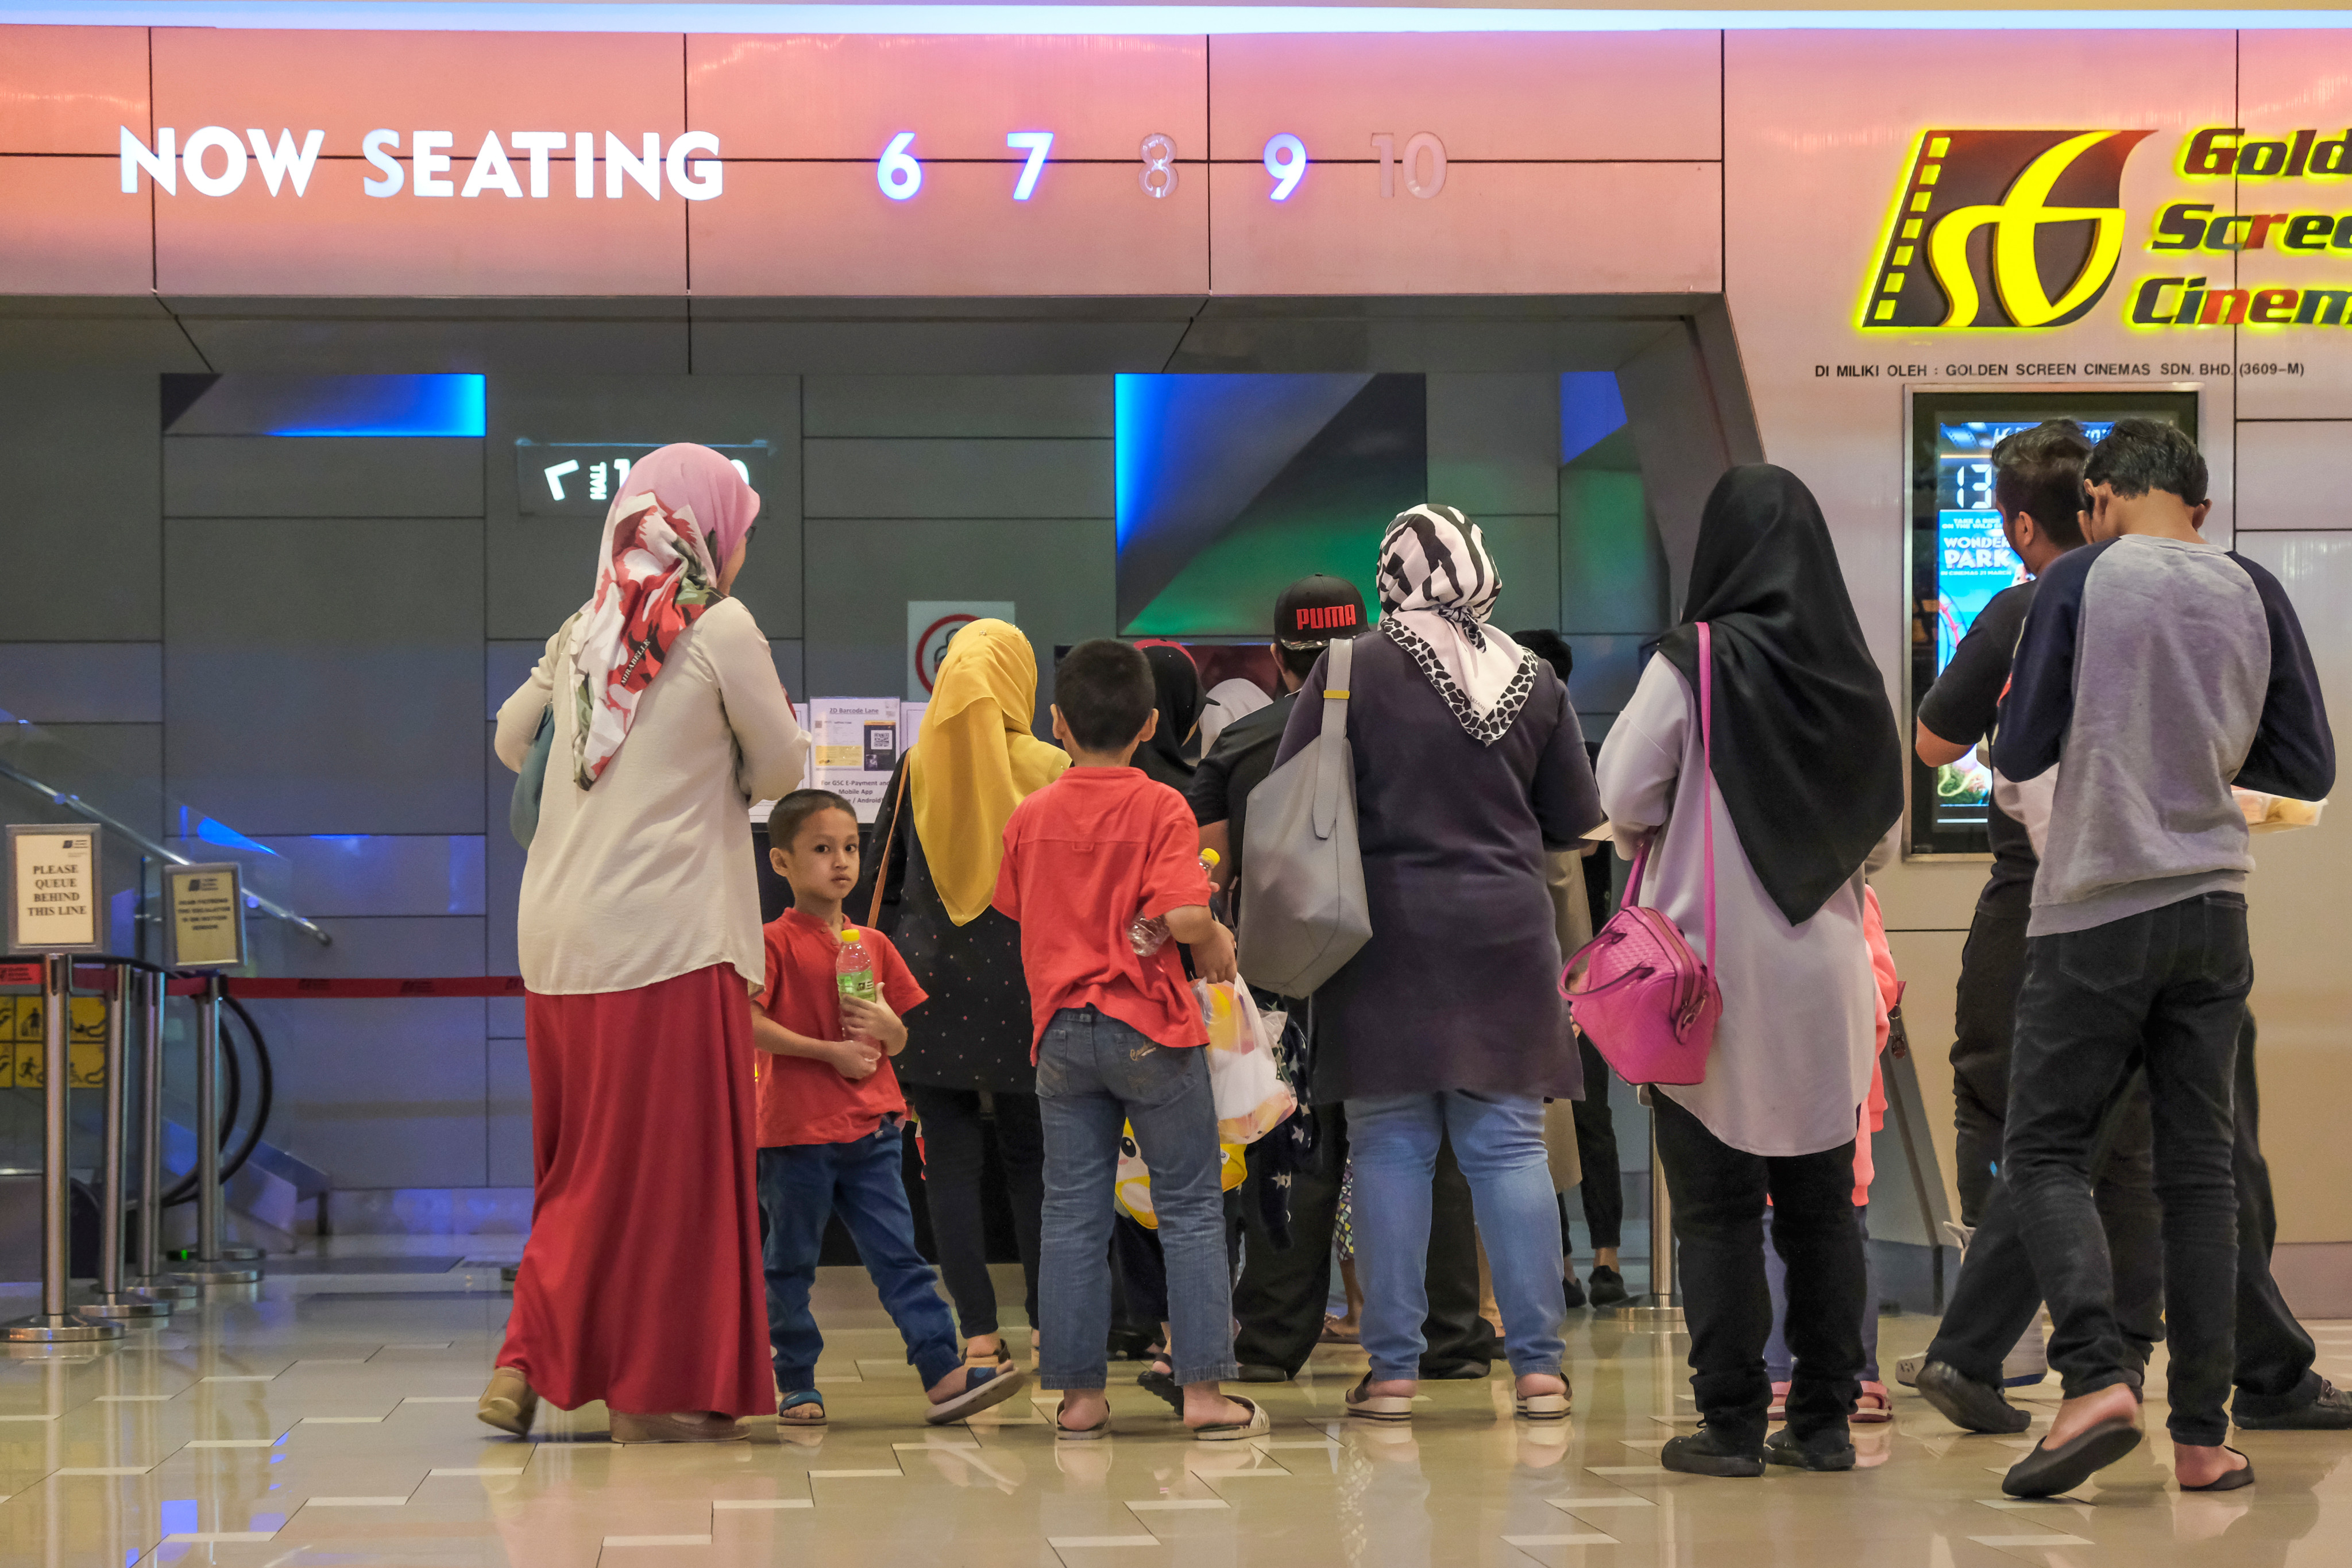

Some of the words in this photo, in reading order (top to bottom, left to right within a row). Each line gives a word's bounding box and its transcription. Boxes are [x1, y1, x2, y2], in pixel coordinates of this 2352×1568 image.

[121, 125, 325, 198] NOW
[362, 128, 724, 201] SEATING
[2184, 128, 2352, 177] Gold
[876, 132, 922, 201] 6
[1007, 132, 1055, 200] 7
[1138, 133, 1179, 198] 8
[1264, 132, 1307, 201] 9
[1370, 131, 1448, 199] 10
[1815, 365, 1829, 377] DI
[1837, 365, 1879, 377] MILIKI
[1887, 364, 1927, 377] OLEH
[1946, 364, 2008, 377] GOLDEN
[2016, 363, 2076, 376] SCREEN
[2084, 363, 2150, 376] CINEMAS
[2160, 363, 2194, 376] SDN.
[2200, 363, 2233, 376] BHD.
[1957, 464, 1992, 509] 13
[1944, 549, 2010, 570] PARK
[1296, 604, 1356, 630] PUMA
[620, 639, 651, 686] MIRABELLE
[33, 864, 79, 874] PLEASE
[35, 879, 77, 890] QUEUE
[34, 893, 80, 902] BEHIND
[28, 906, 55, 916] THIS
[58, 905, 86, 915] LINE
